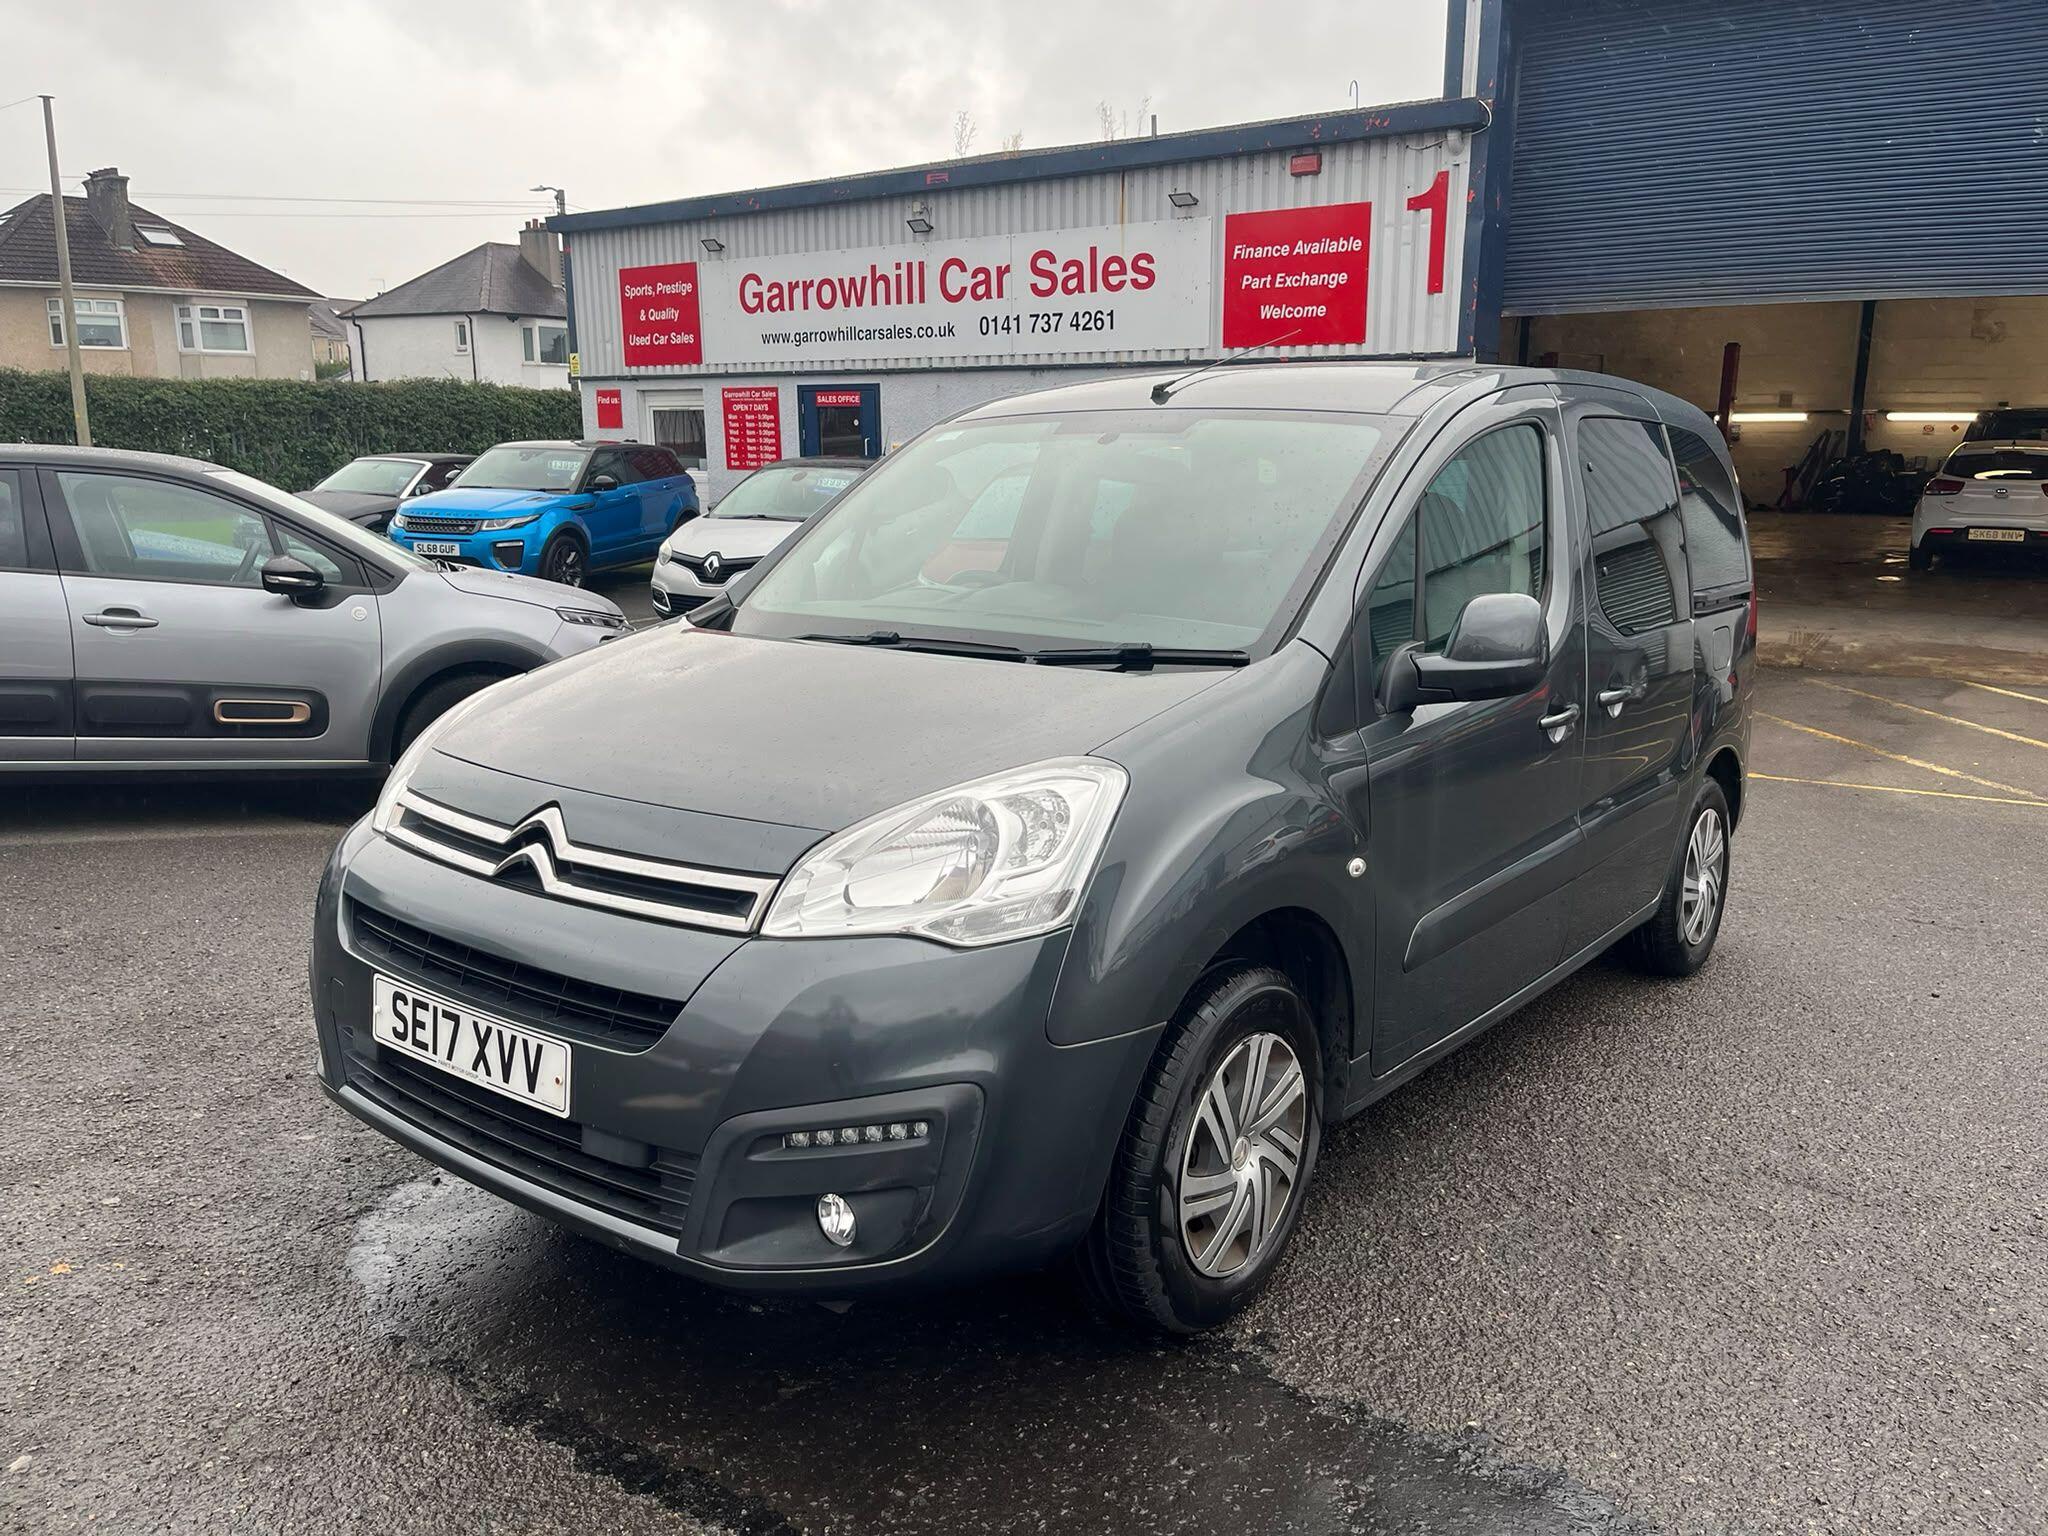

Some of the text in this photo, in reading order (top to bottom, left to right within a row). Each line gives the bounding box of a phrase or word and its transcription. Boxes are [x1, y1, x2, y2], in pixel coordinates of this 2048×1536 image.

[1407, 170, 1449, 295] 1
[1233, 236, 1362, 260] Finance Available
[739, 246, 1157, 315] Garrowhill Car Sales
[1241, 271, 1348, 290] Part Exchange
[624, 280, 693, 299] Sports, Prestige
[640, 307, 680, 322] & Quality
[1260, 303, 1327, 320] Welcome
[761, 309, 1116, 347] www.garrowhillcarsales.co.uk 0141 737 4261
[629, 331, 695, 346] Used Car Sales
[597, 396, 609, 404] Find
[723, 390, 776, 398] Garrowhill Car Sales
[816, 395, 860, 403] SALES OFFICE
[732, 403, 769, 411] OPEN 7 DAYS
[1973, 530, 2020, 539] SK68 WNV
[416, 543, 456, 554] SL68 GUF
[391, 990, 544, 1095] SE17 XVV
